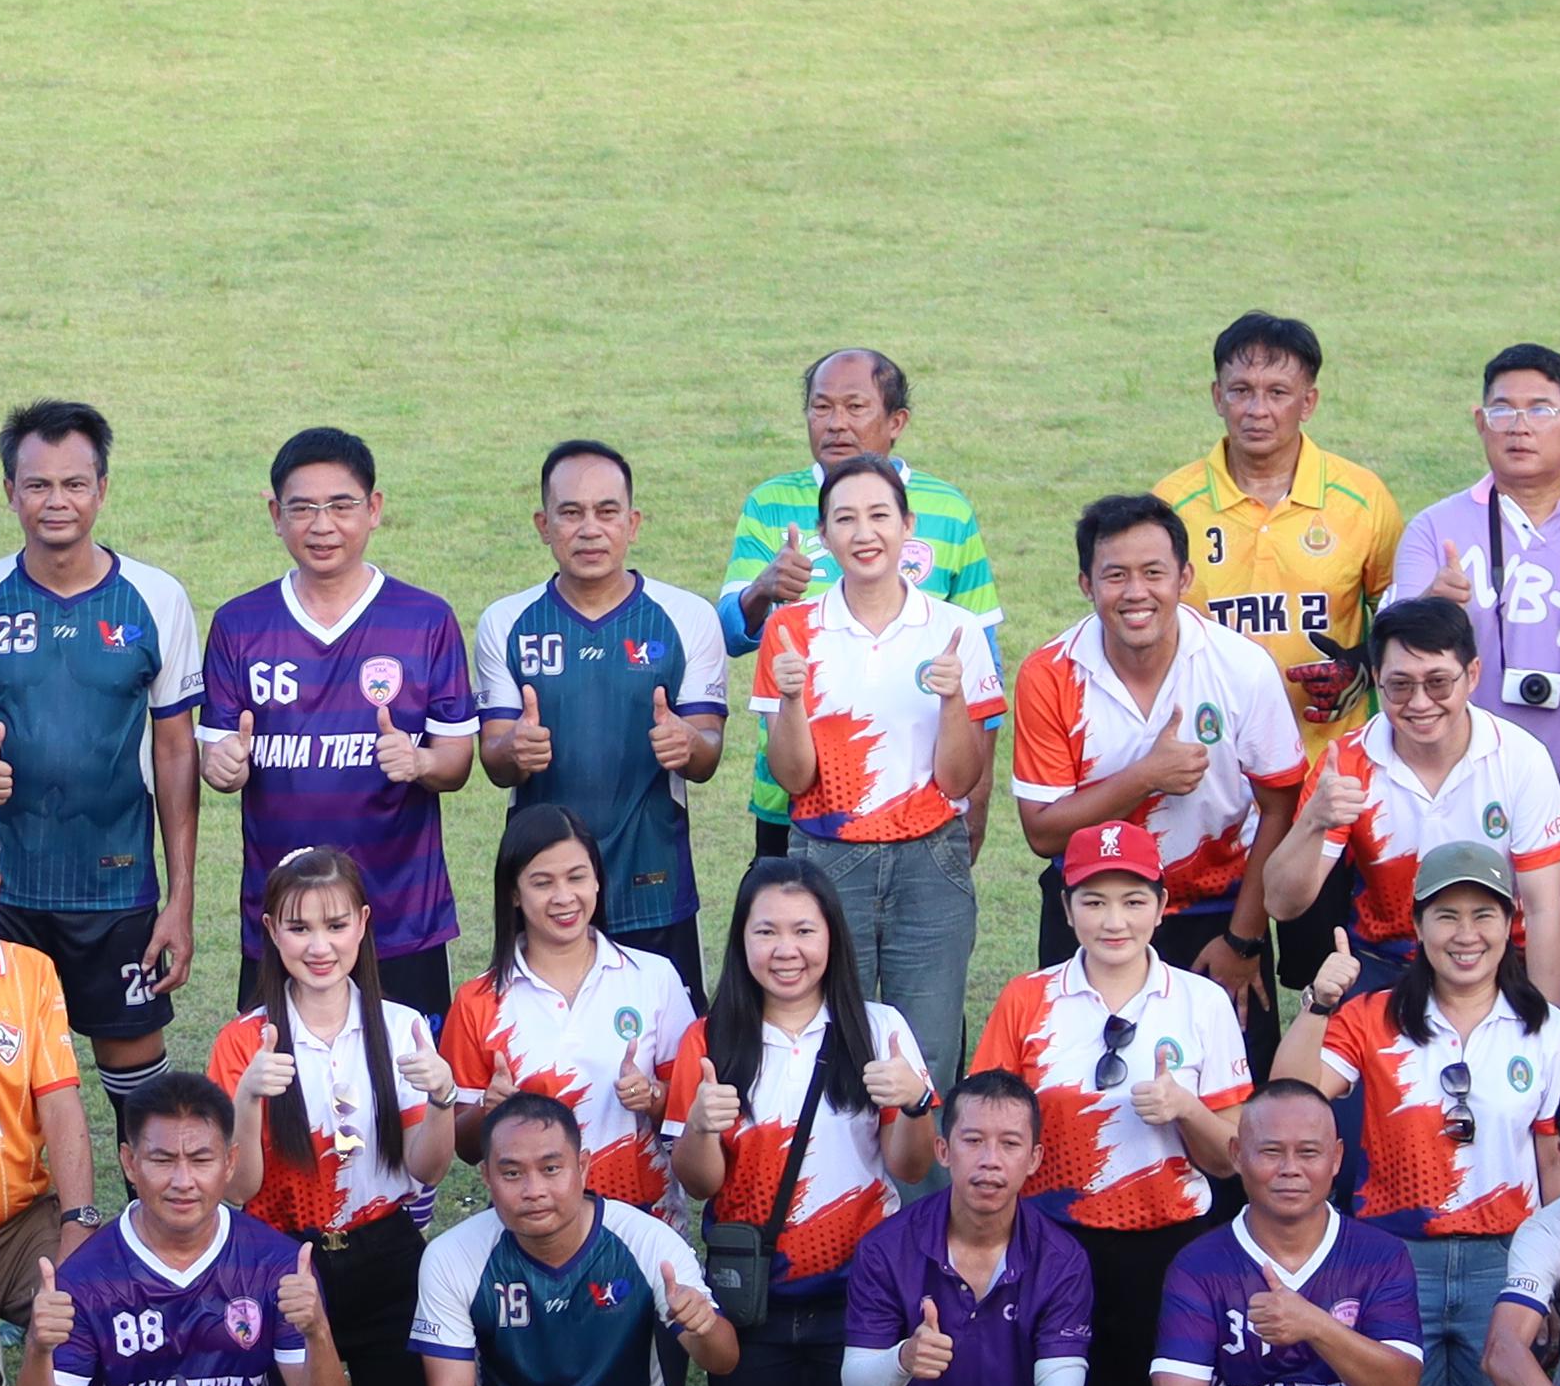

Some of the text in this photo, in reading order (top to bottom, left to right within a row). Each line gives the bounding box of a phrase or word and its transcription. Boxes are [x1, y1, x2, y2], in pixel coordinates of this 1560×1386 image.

[1206, 526, 1224, 565] 3
[1207, 592, 1329, 634] TAK 2
[518, 633, 565, 677] 50
[249, 660, 299, 706] 66
[318, 732, 378, 771] TREE
[113, 1308, 165, 1357] 88
[1222, 1309, 1272, 1356] 3
